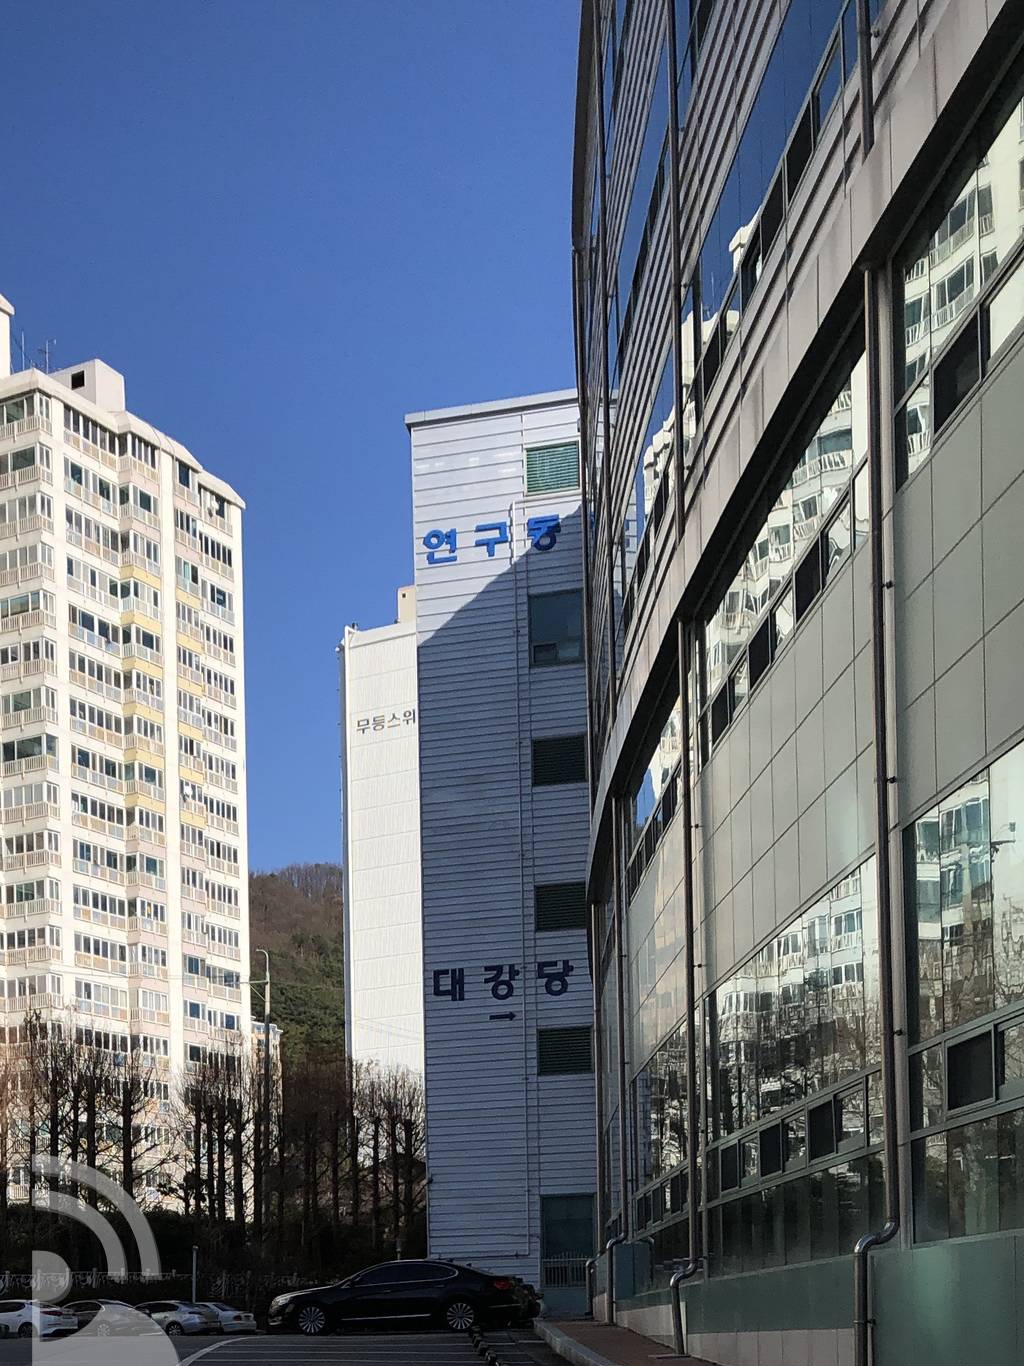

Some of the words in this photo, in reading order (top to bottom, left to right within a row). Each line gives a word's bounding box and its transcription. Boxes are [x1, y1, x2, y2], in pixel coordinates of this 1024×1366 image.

[423, 514, 562, 565] 연구동
[356, 708, 416, 735] 무등스위
[433, 959, 574, 1001] 대강당
